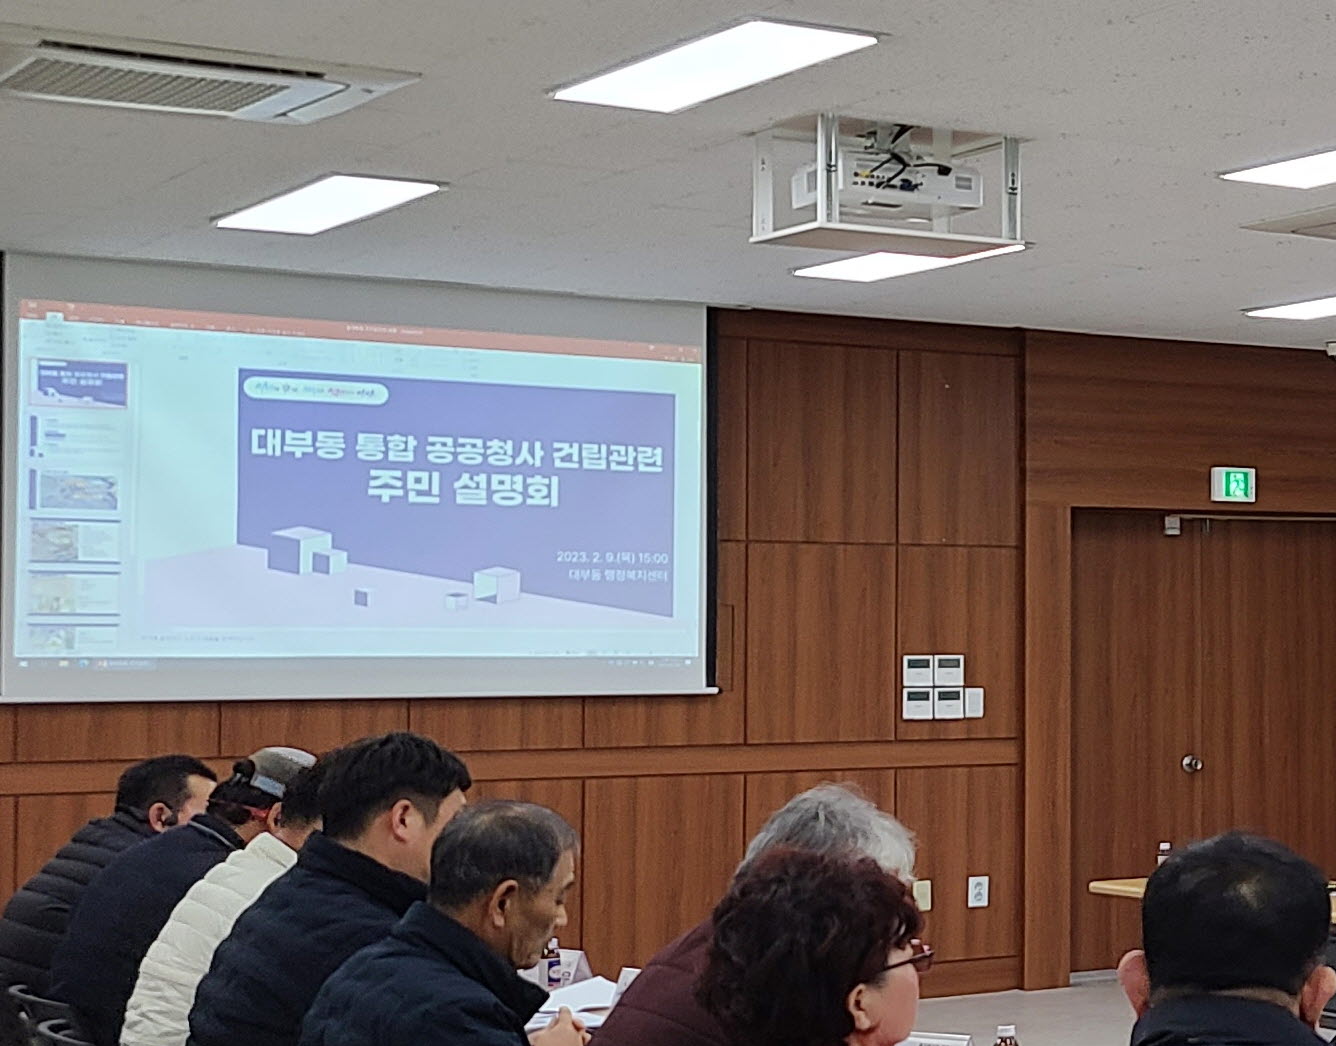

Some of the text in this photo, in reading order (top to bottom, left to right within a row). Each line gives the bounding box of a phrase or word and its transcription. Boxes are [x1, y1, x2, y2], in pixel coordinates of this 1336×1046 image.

[251, 427, 664, 473] 대부동 통합 공공청사 건립관련
[367, 468, 560, 508] 주민 설명회
[556, 550, 588, 563] 2023.
[639, 552, 669, 565] 15:00
